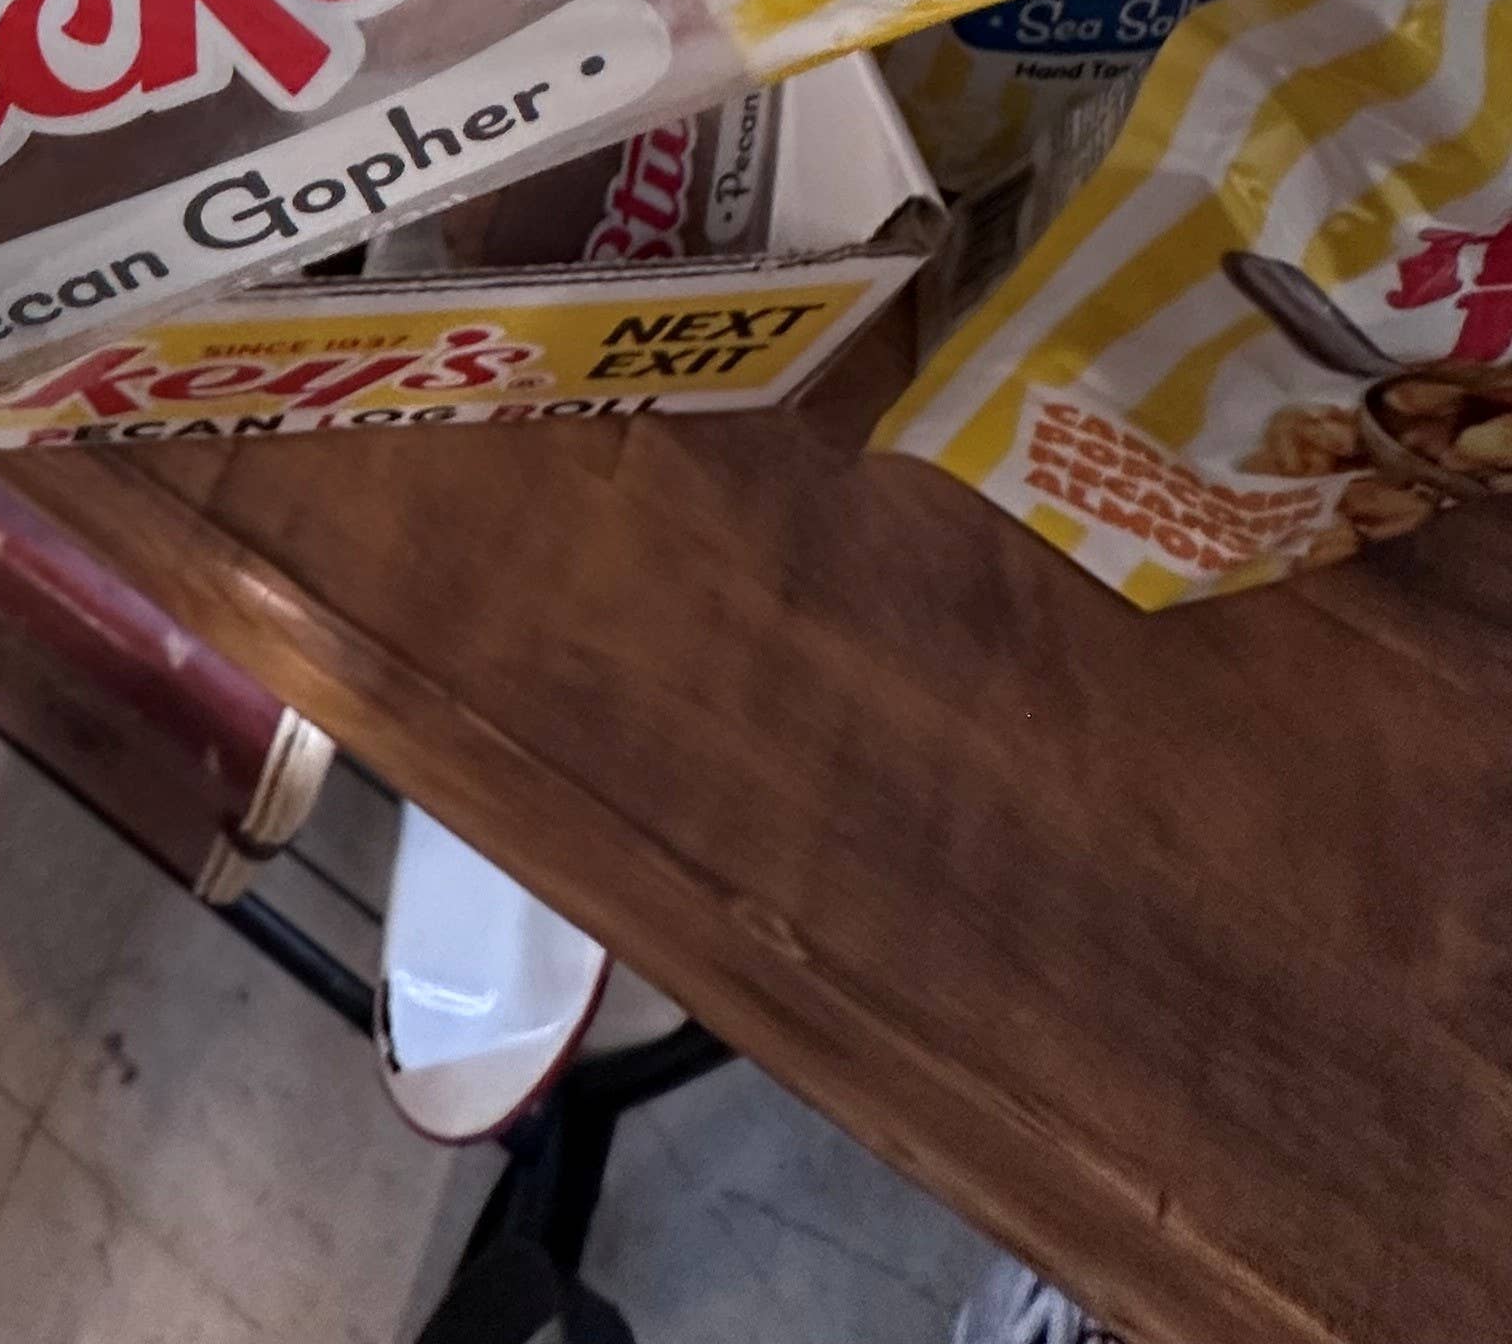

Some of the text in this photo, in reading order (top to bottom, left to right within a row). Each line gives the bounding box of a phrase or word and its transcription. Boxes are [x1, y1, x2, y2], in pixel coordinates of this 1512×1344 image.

[182, 78, 550, 252] Gopher
[714, 93, 760, 204] Pecan
[600, 302, 826, 348] NEXT
[586, 342, 770, 382] EXIT
[26, 414, 284, 446] PECAN
